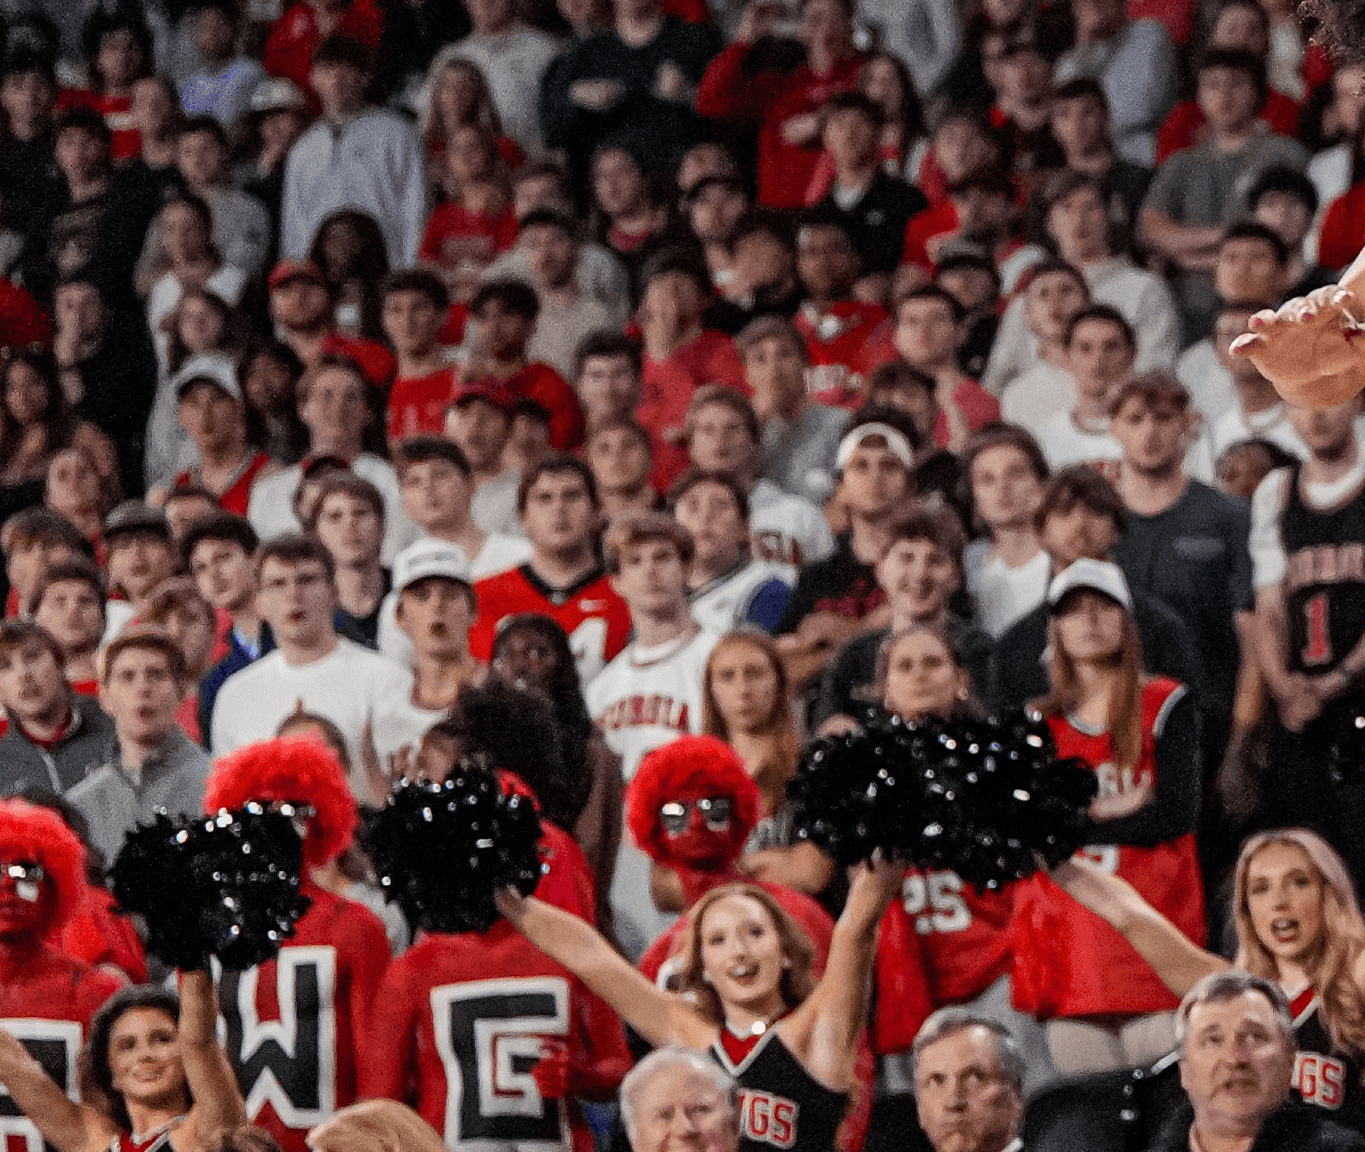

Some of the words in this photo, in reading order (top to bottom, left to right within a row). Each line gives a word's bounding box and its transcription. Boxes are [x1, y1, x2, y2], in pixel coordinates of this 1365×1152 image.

[1304, 595, 1332, 664] 1
[1291, 1050, 1347, 1110] GS
[734, 1088, 801, 1149] GS
